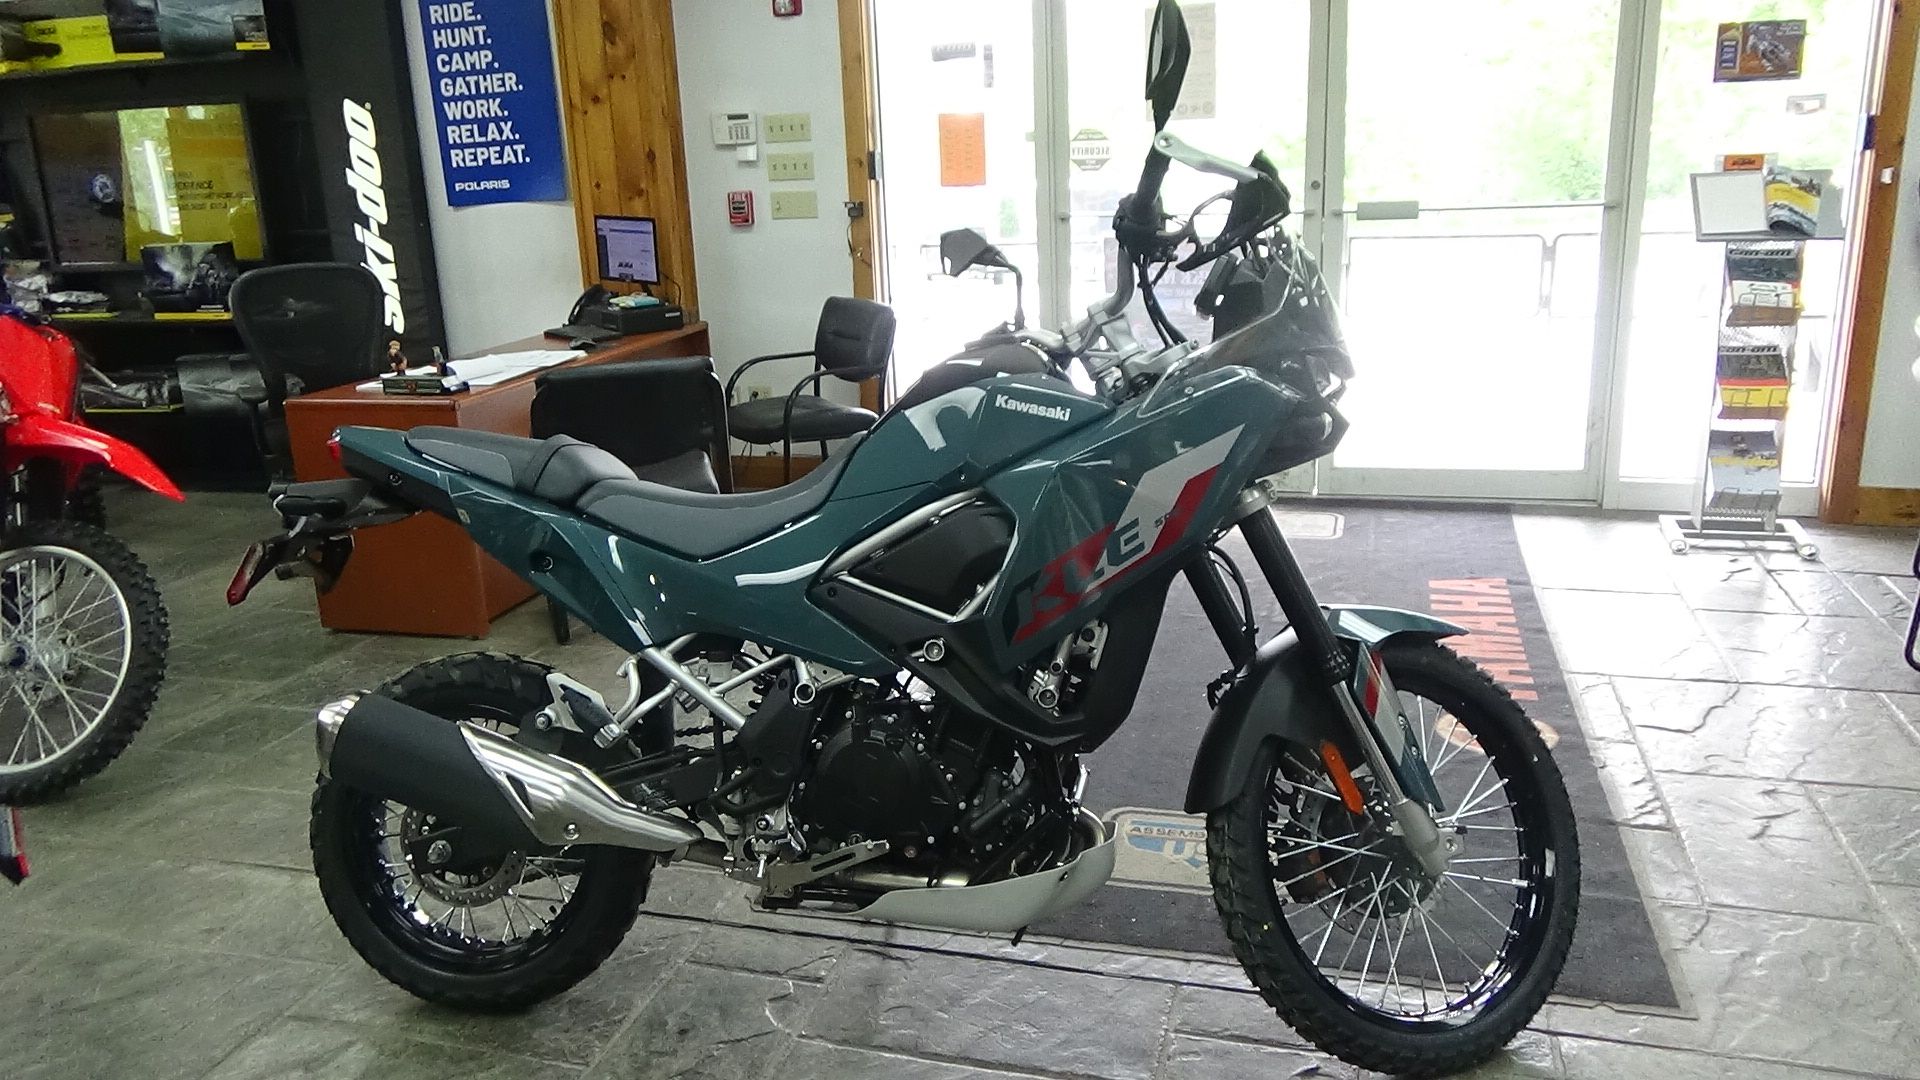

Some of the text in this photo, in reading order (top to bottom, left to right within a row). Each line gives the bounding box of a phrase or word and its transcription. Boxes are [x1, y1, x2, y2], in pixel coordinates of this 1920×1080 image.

[429, 2, 482, 25] RIDE.
[432, 25, 492, 49] HUNT.
[436, 49, 499, 73] CAMP.
[440, 72, 523, 97] GATHER.
[442, 97, 509, 121] WORK.
[446, 121, 520, 145] RELAX.
[449, 144, 531, 168] REPEAT.
[454, 179, 510, 192] POLARIS
[995, 394, 1072, 422] Kawasaki
